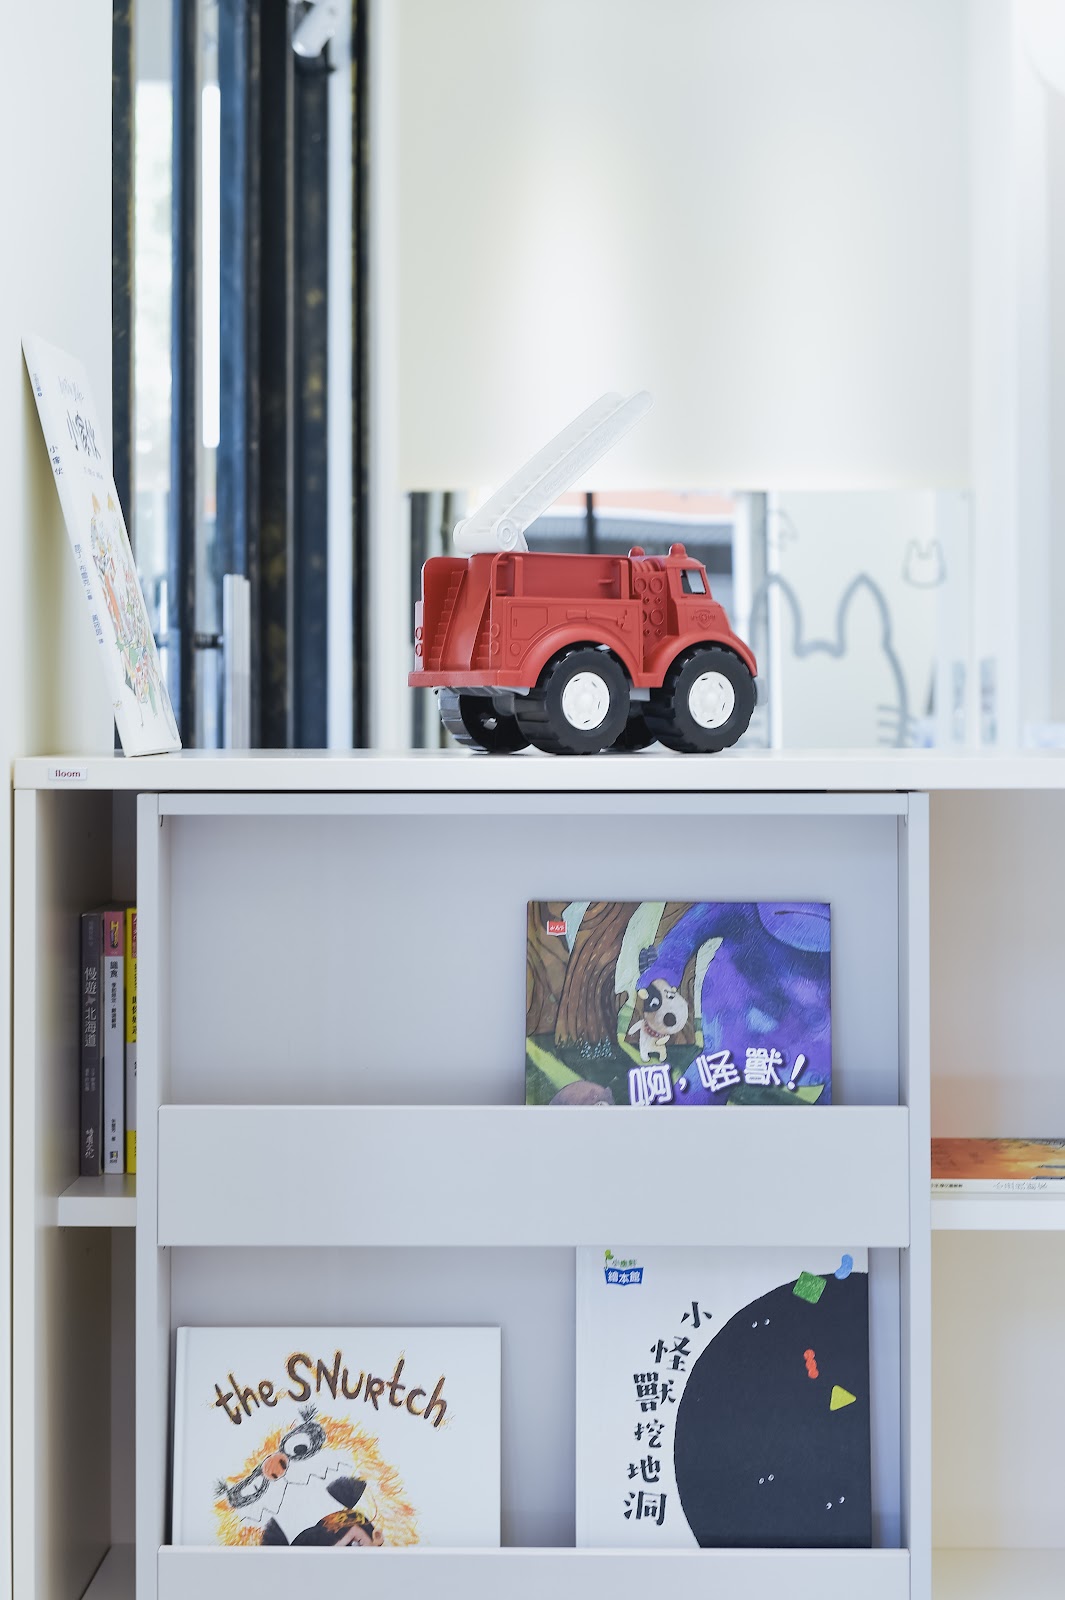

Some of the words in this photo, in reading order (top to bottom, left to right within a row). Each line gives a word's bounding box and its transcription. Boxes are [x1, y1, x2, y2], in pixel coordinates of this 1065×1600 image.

[607, 1270, 641, 1284] 繪本館
[213, 1373, 279, 1425] the
[623, 1301, 713, 1527] 小怪獸挖地洞
